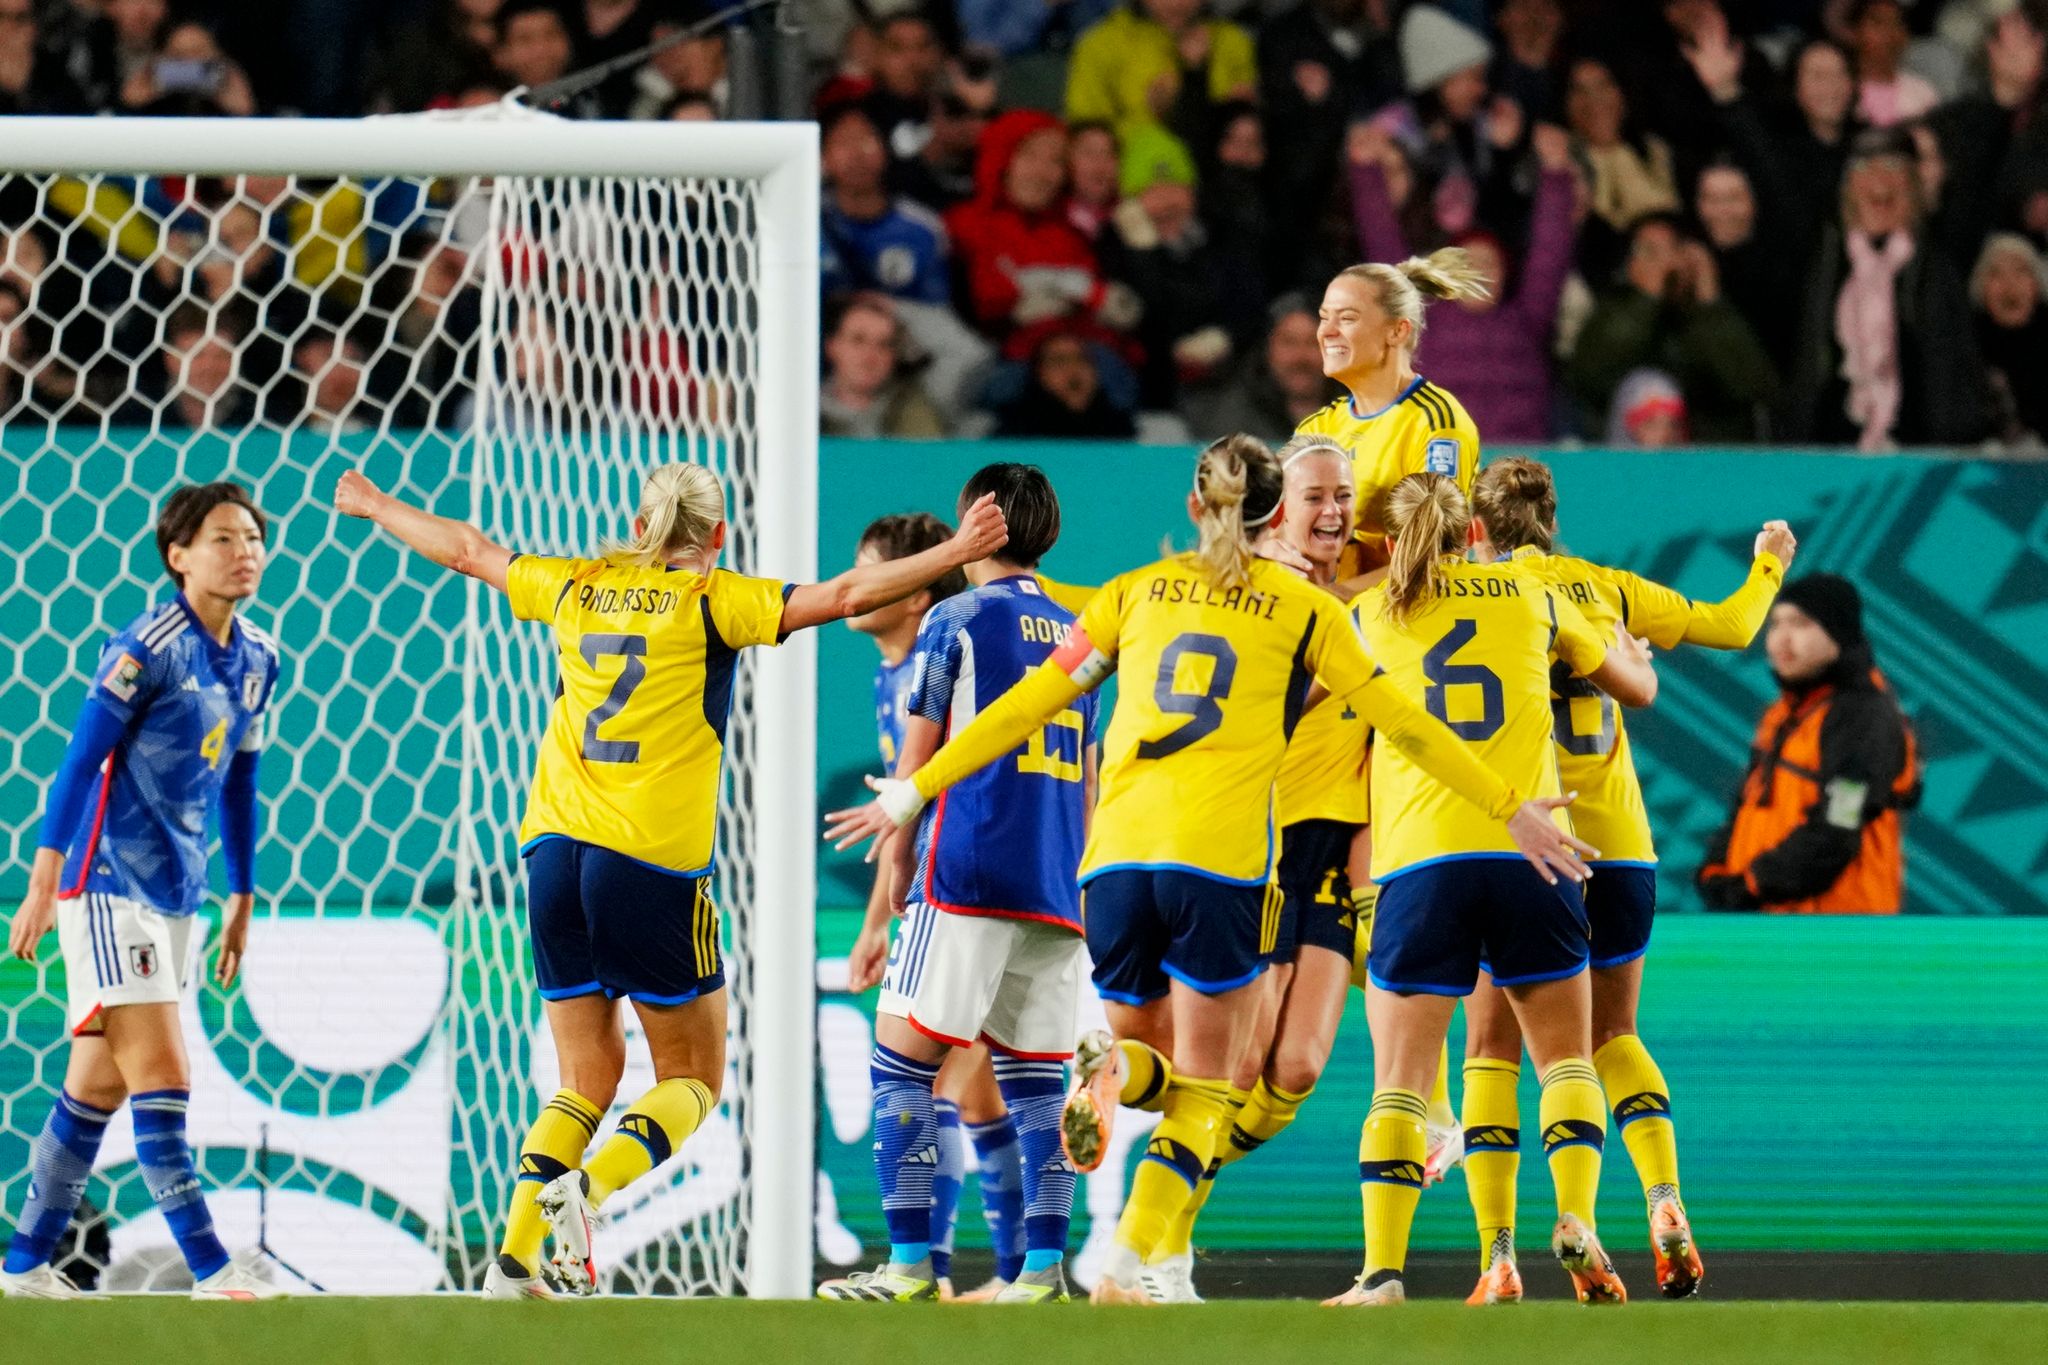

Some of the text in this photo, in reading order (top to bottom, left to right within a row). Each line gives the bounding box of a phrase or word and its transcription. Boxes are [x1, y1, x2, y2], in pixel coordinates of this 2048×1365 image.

[579, 633, 648, 764] 2
[1136, 632, 1238, 761] 9
[1423, 618, 1505, 742] 6
[1550, 658, 1616, 756] 6
[199, 716, 229, 771] 4
